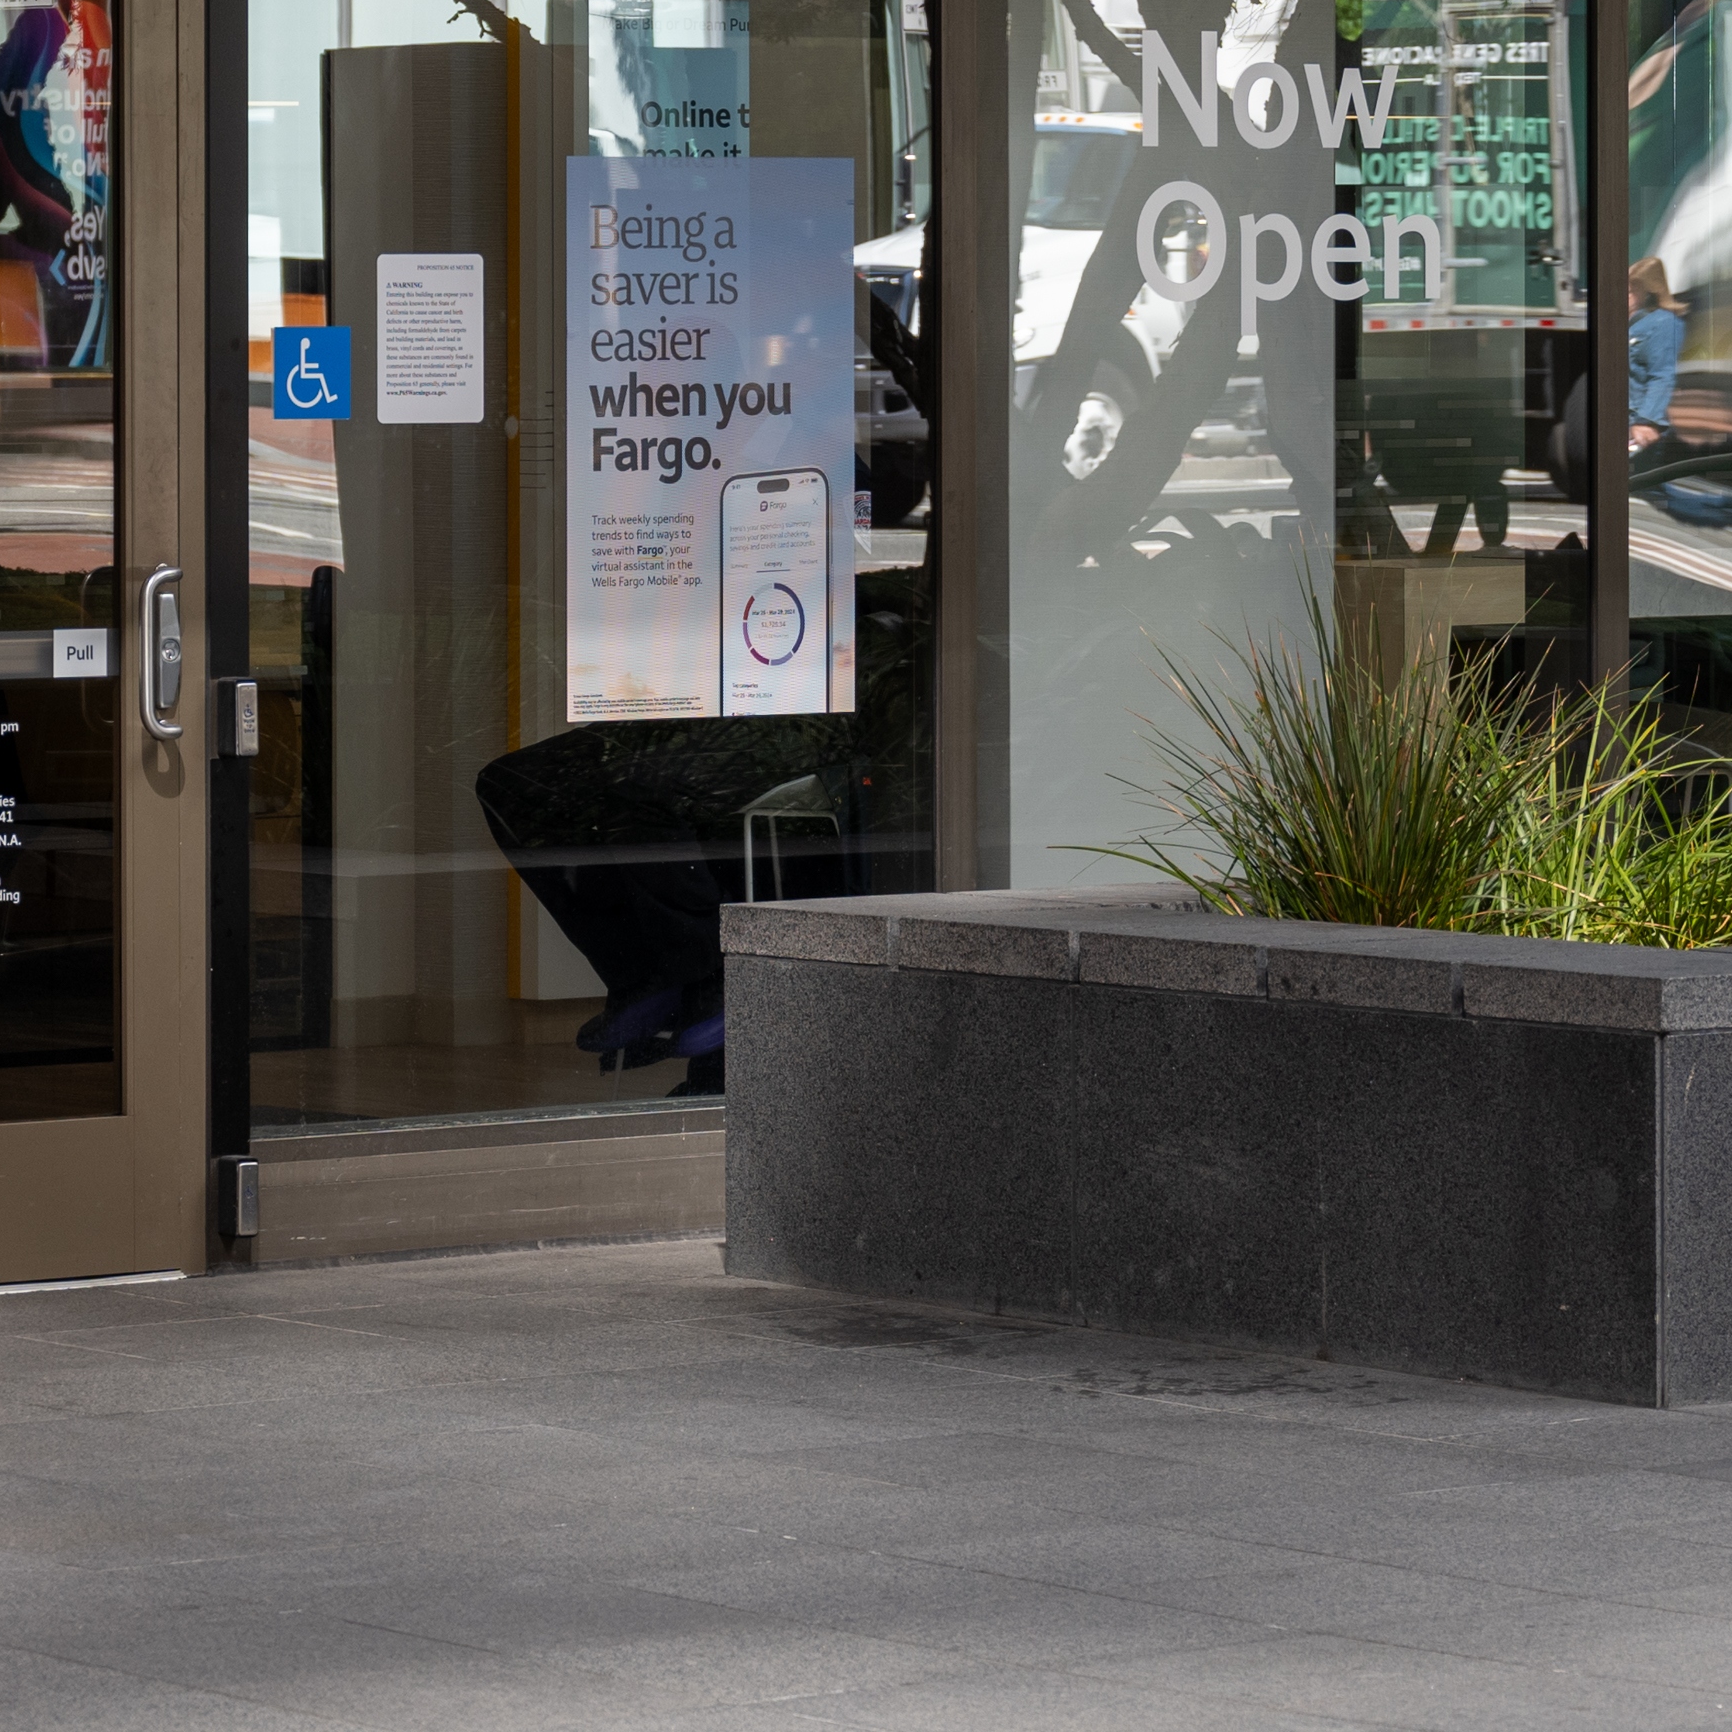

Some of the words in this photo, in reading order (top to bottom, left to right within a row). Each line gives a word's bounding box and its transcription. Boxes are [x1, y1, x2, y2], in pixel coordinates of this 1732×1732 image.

[1140, 29, 1399, 150] Now
[641, 100, 730, 128] Online
[643, 142, 715, 158] make
[723, 142, 742, 158] it
[590, 204, 707, 262] Being
[714, 214, 737, 249] a
[1136, 180, 1441, 336] Open
[590, 271, 699, 305] saver
[706, 259, 739, 305] is
[590, 316, 711, 362] easier
[589, 371, 707, 418] when
[714, 382, 792, 430] you
[592, 428, 721, 485] Fargo.
[591, 514, 617, 525] Track
[618, 514, 650, 527] weekly
[652, 513, 694, 526] spending
[592, 530, 622, 540] trends
[624, 531, 634, 540] to
[636, 529, 654, 540] find
[656, 531, 679, 541] ways
[681, 530, 692, 538] to
[592, 548, 613, 556] save
[614, 545, 635, 555] with
[669, 546, 691, 557] your
[592, 561, 621, 572] virtual
[623, 560, 665, 571] assistant
[667, 560, 675, 570] in
[677, 559, 693, 569] the
[592, 576, 617, 587] Wells
[618, 576, 645, 589] Fargo
[683, 576, 703, 587] app.
[67, 645, 94, 661] Pull
[0, 722, 19, 736] pm
